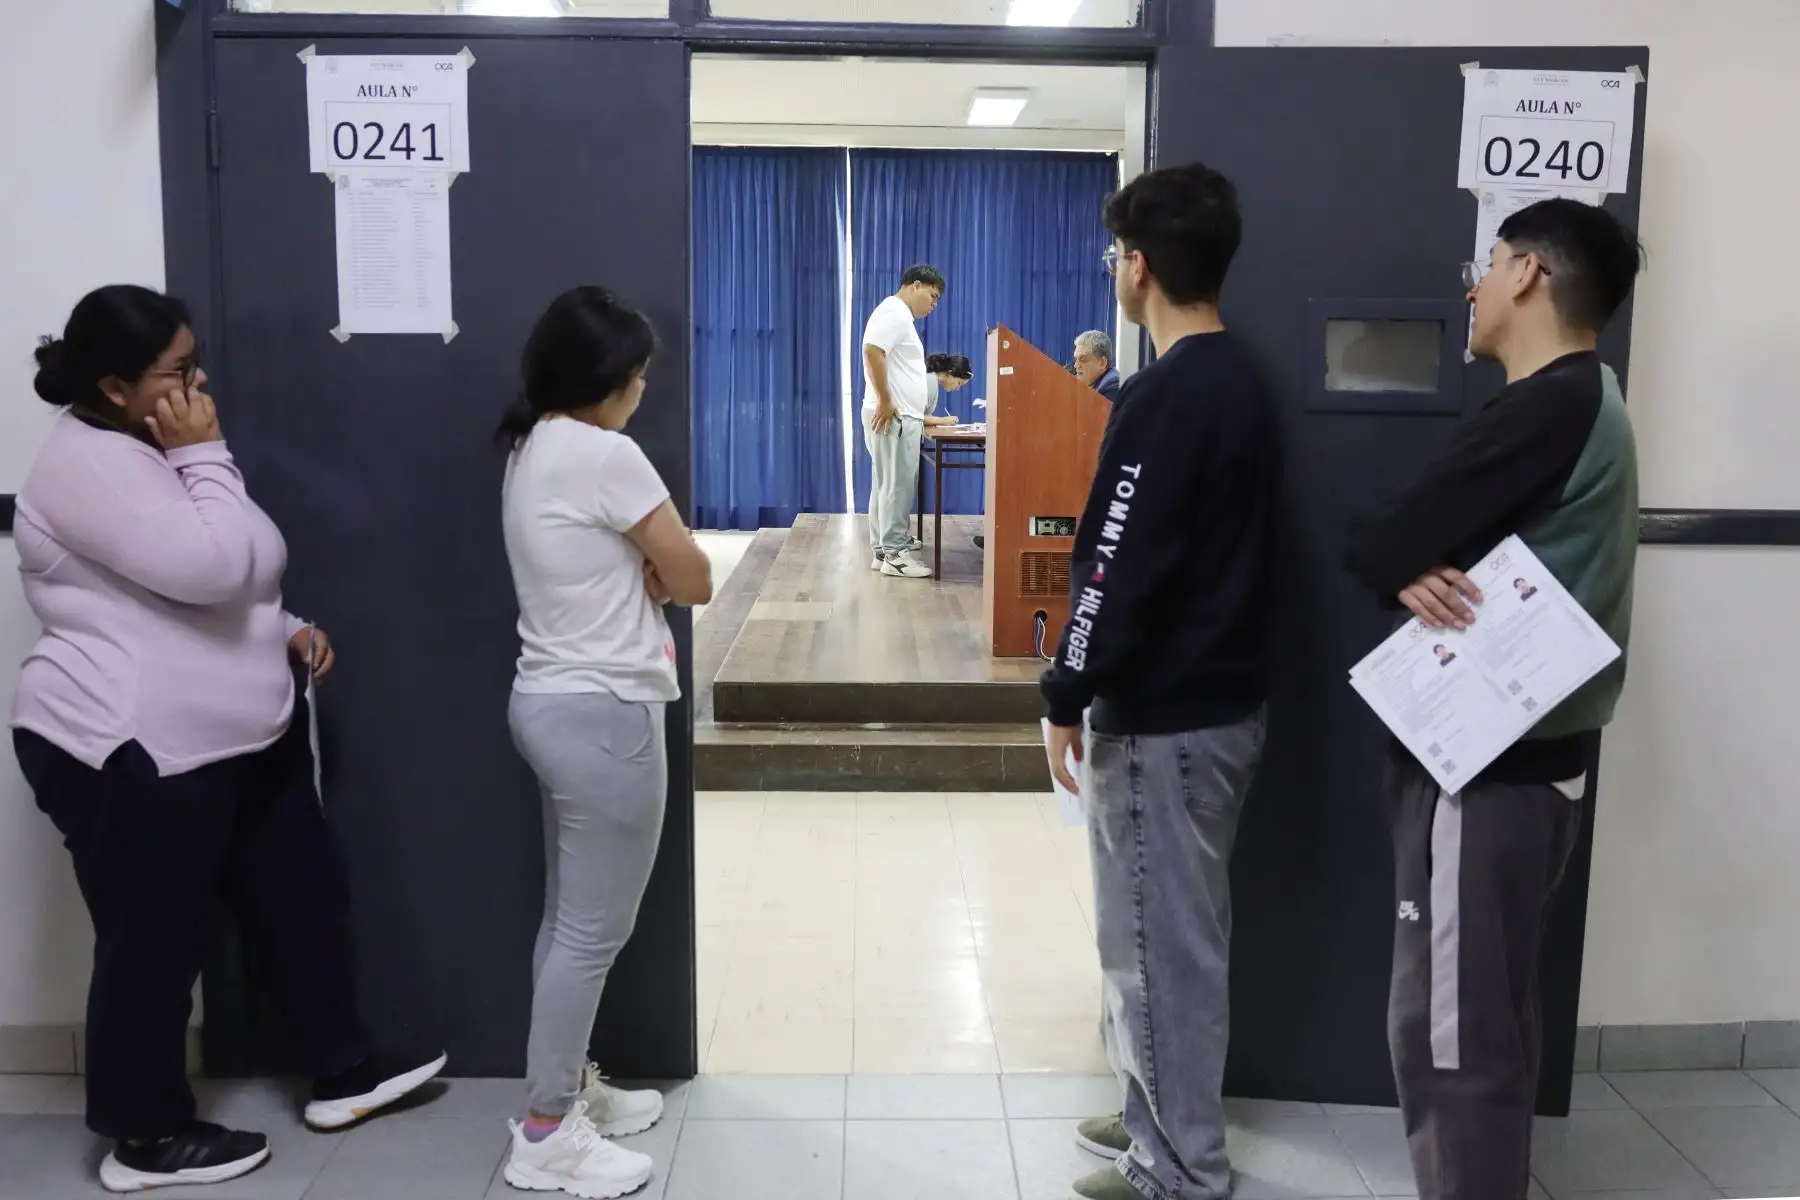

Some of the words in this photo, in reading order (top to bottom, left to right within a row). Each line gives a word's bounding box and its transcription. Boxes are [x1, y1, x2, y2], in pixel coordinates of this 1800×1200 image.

[356, 84, 398, 98] AULA
[1600, 79, 1620, 88] OCA
[1515, 99, 1559, 114] AULA
[333, 121, 444, 161] 0241
[1484, 136, 1605, 181] 0240
[1096, 463, 1142, 559] TOMMY
[1064, 586, 1104, 672] HILFIGER
